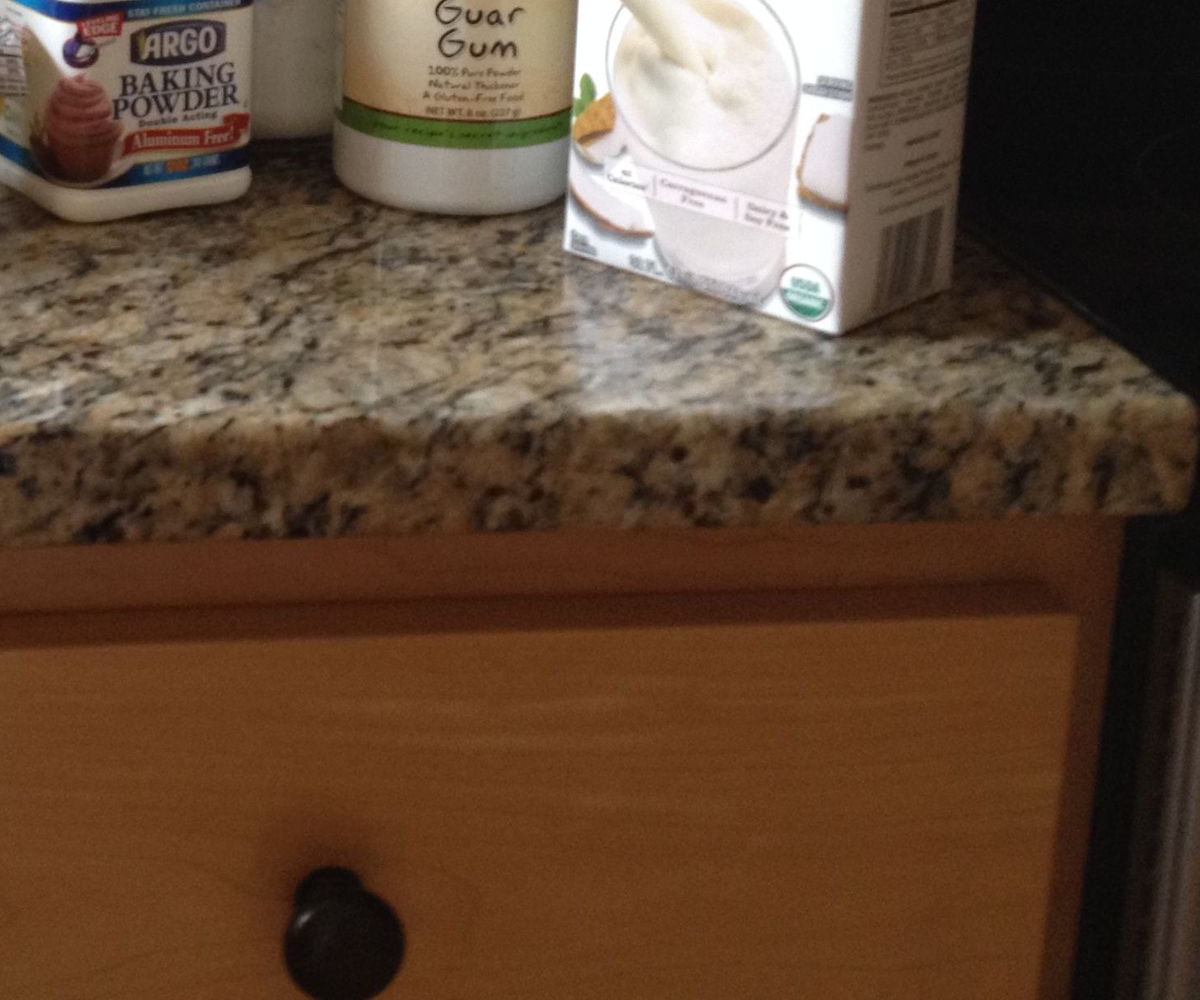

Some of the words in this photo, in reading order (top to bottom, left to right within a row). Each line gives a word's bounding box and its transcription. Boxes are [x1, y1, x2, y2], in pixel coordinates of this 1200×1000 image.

[143, 26, 218, 60] ARGO
[438, 27, 518, 58] Gum
[119, 61, 236, 98] BAKING
[428, 64, 459, 77] 100%
[112, 83, 239, 121] POWDER
[138, 116, 179, 128] Double
[181, 110, 219, 123] Acting
[131, 133, 201, 149] Aluminum
[203, 126, 236, 146] Free!
